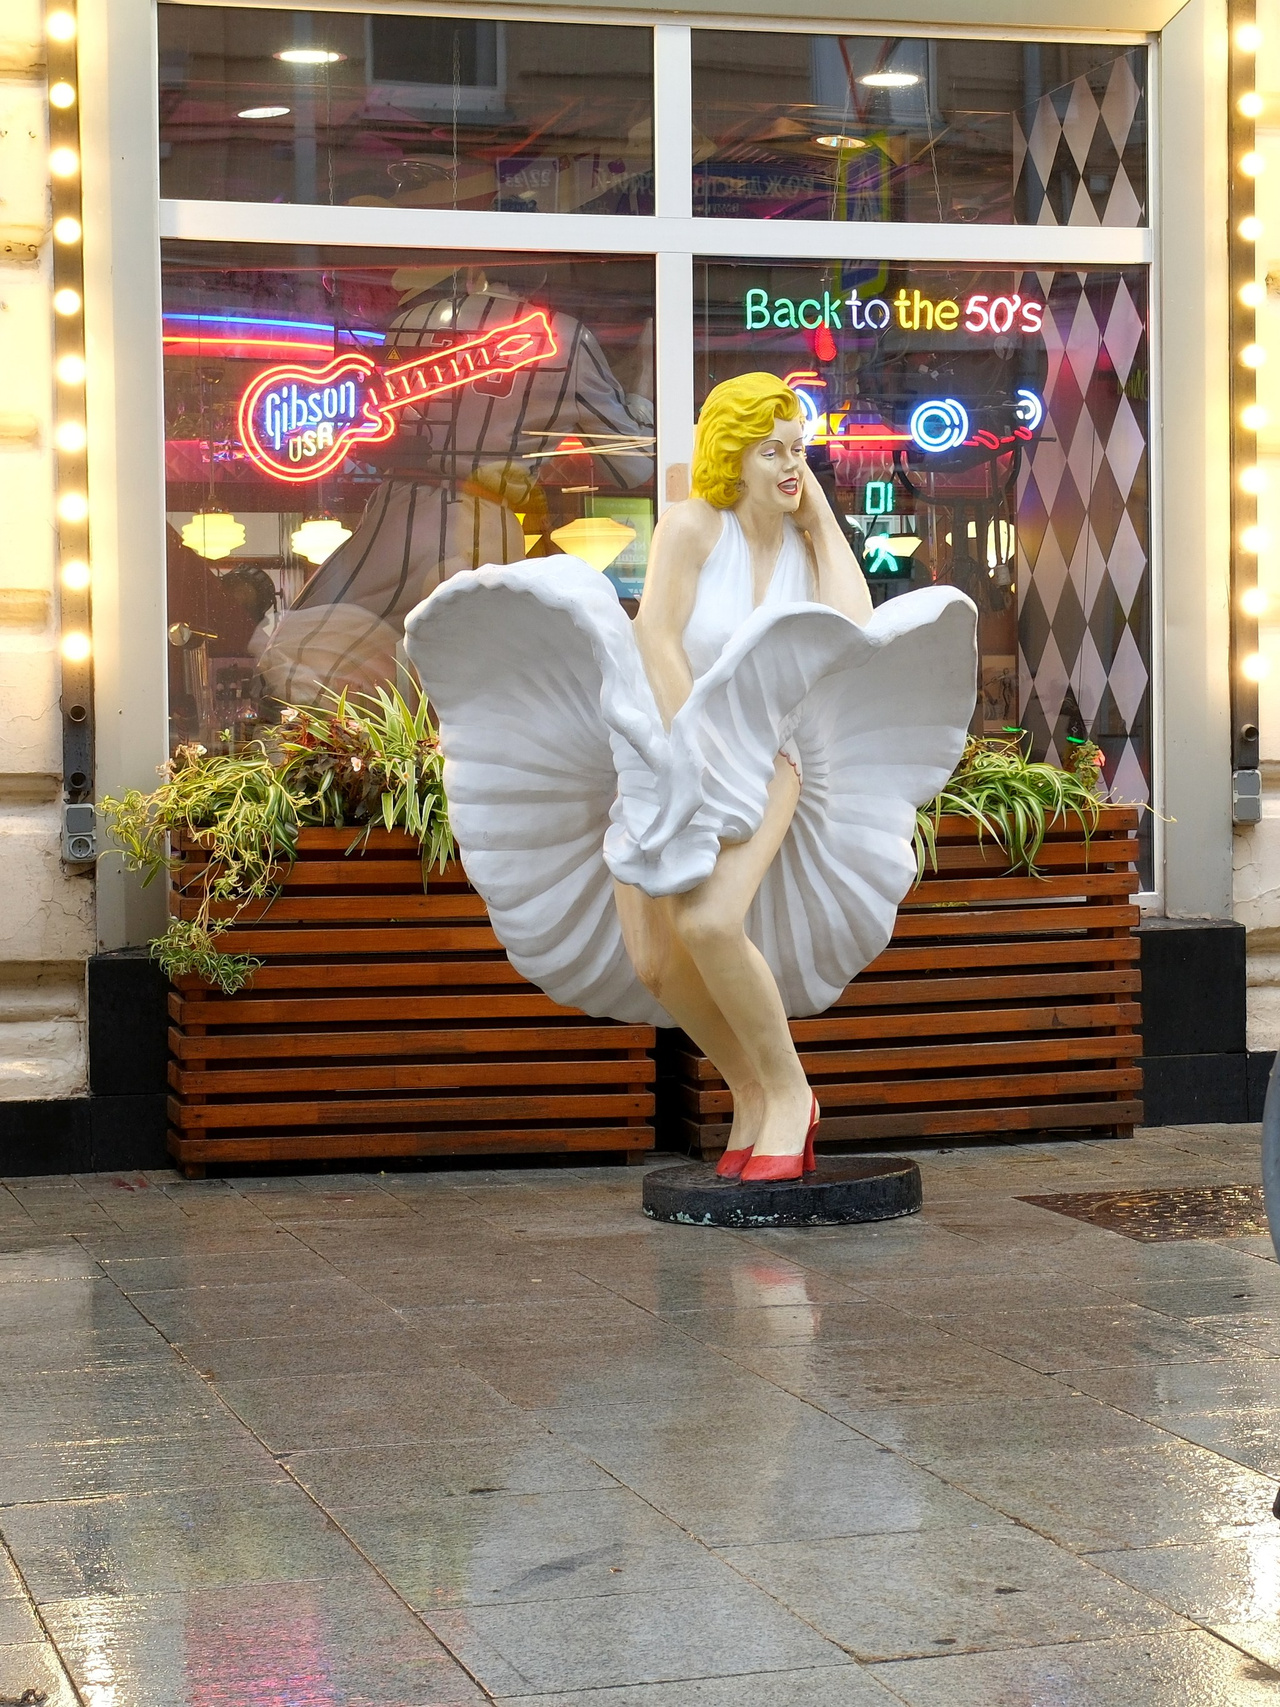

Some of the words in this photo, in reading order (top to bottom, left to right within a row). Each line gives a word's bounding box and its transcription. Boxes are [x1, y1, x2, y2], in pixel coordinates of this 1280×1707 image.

[746, 288, 841, 330] Back
[845, 288, 890, 330] to
[894, 288, 959, 331] the
[965, 294, 1042, 333] 50's
[265, 381, 356, 451] Gibson
[288, 421, 334, 462] USA
